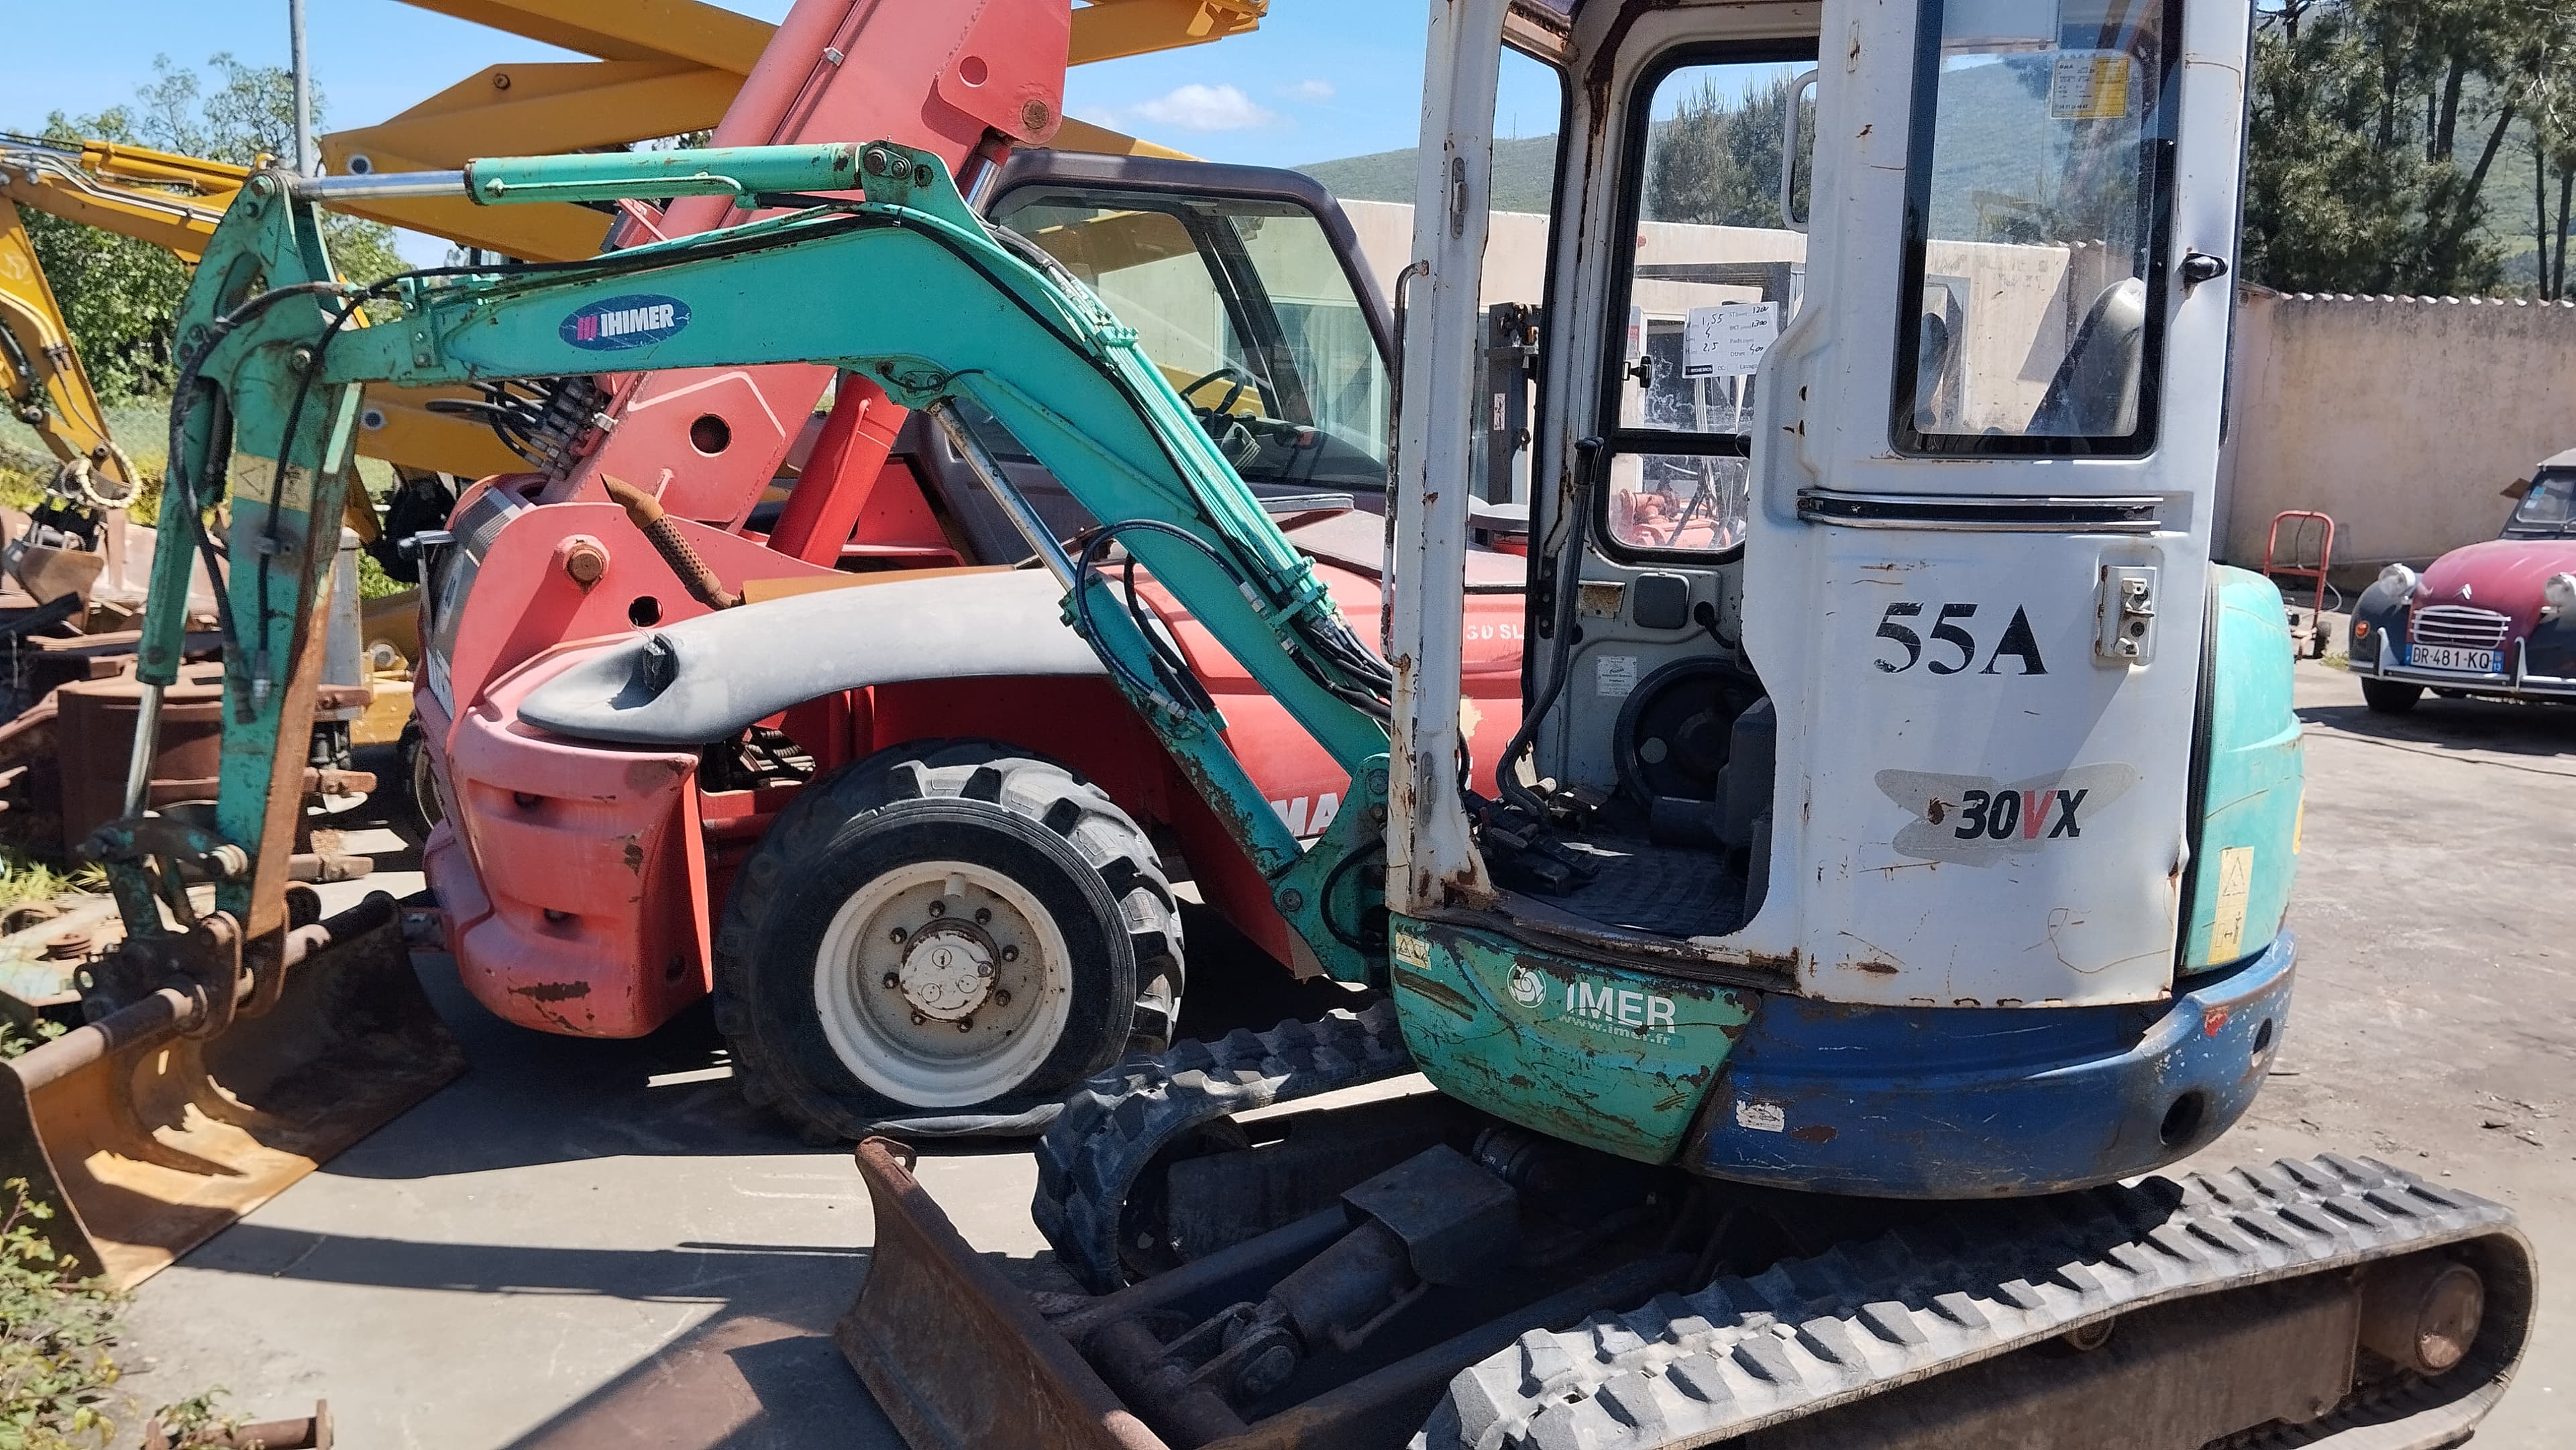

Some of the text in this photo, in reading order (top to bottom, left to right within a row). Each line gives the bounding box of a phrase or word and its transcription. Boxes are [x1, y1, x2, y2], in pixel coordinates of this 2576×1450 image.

[600, 303, 675, 338] IHIMER
[1752, 319, 1768, 328] 1300
[1873, 602, 2049, 675] 55A
[2493, 662, 2502, 672] 13
[1953, 788, 2089, 840] 30VX
[1566, 981, 1676, 1034] IMER
